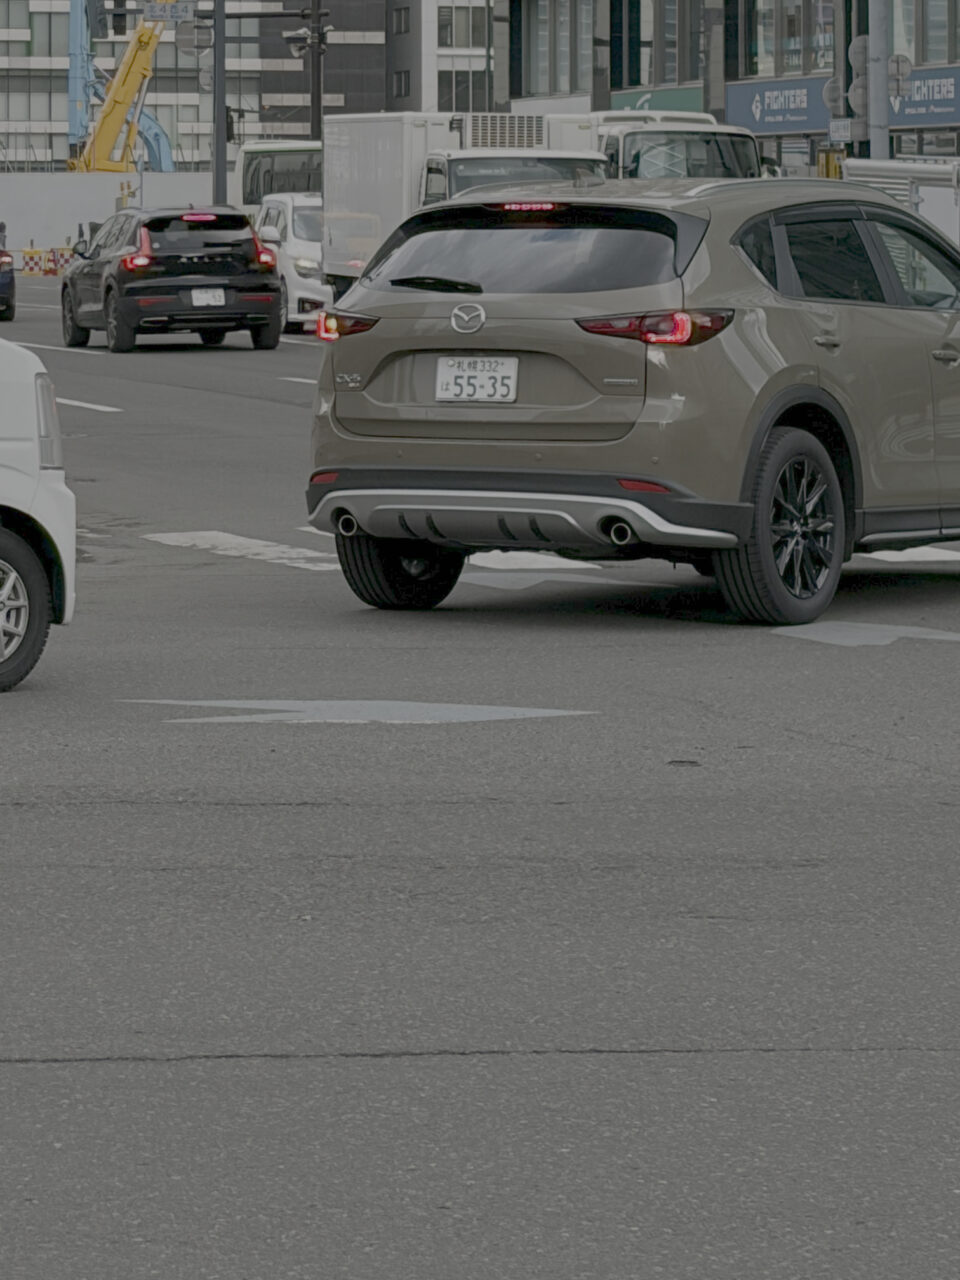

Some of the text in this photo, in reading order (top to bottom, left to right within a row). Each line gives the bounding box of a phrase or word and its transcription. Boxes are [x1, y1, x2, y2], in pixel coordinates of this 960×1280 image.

[764, 88, 808, 111] FIGHTERS
[904, 77, 955, 102] IGHTERS
[453, 375, 512, 398] 55-35
